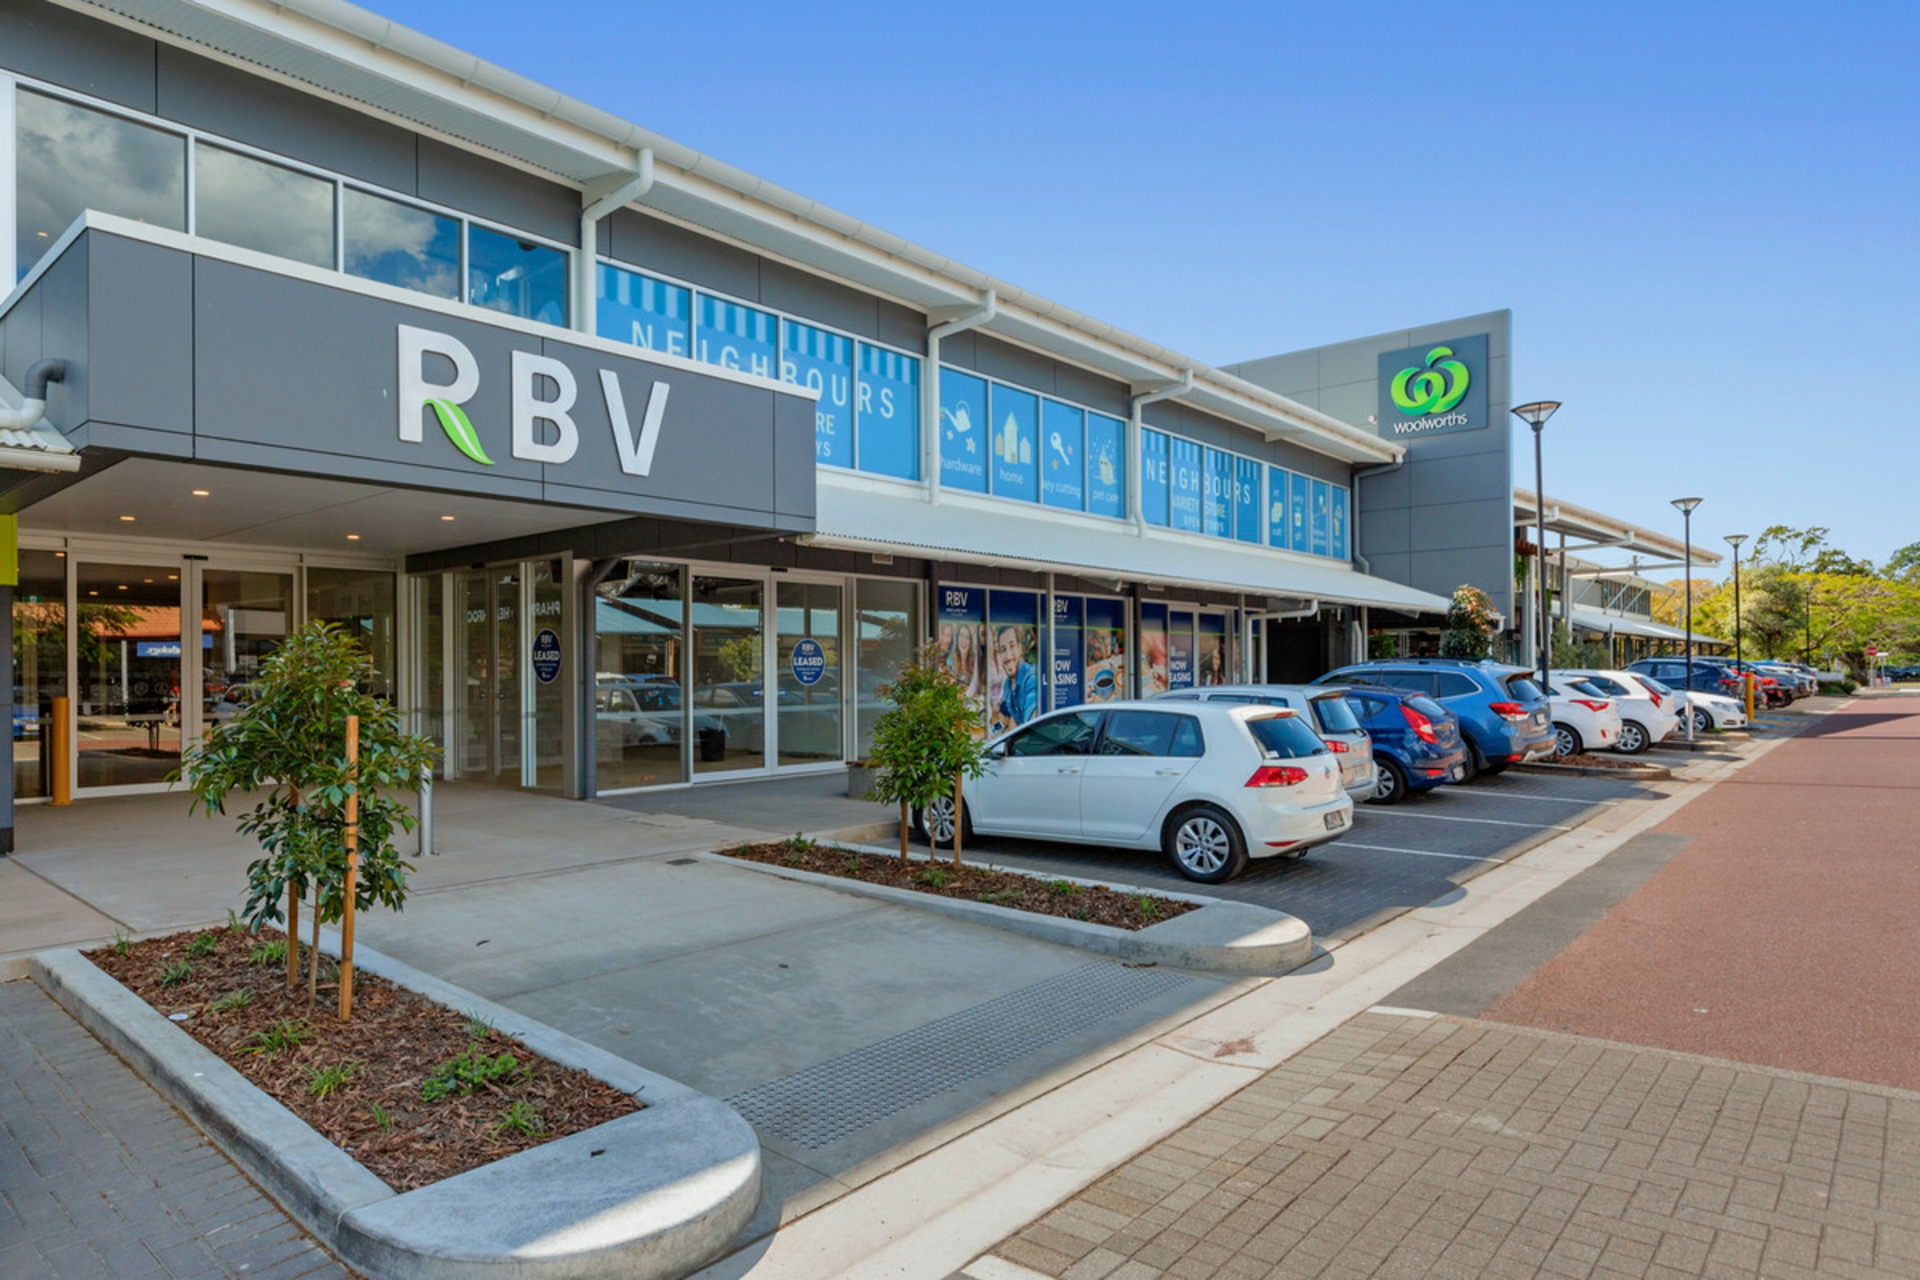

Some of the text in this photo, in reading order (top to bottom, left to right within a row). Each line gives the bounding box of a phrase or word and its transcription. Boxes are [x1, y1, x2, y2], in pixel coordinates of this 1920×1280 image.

[631, 320, 895, 419] NEIGHBOURS
[398, 324, 670, 477] RBV
[1393, 413, 1468, 434] woolworths
[815, 438, 831, 457] YS
[940, 455, 982, 477] hardware
[999, 467, 1024, 484] home
[1146, 457, 1251, 505] NEIGHBOURS
[945, 590, 968, 607] RBV
[533, 650, 560, 662] LEASED
[793, 656, 823, 667] LEASED
[1055, 659, 1071, 672] OW
[1170, 660, 1187, 671] NOW
[1042, 672, 1078, 686] LASING
[1169, 671, 1191, 682] EASING
